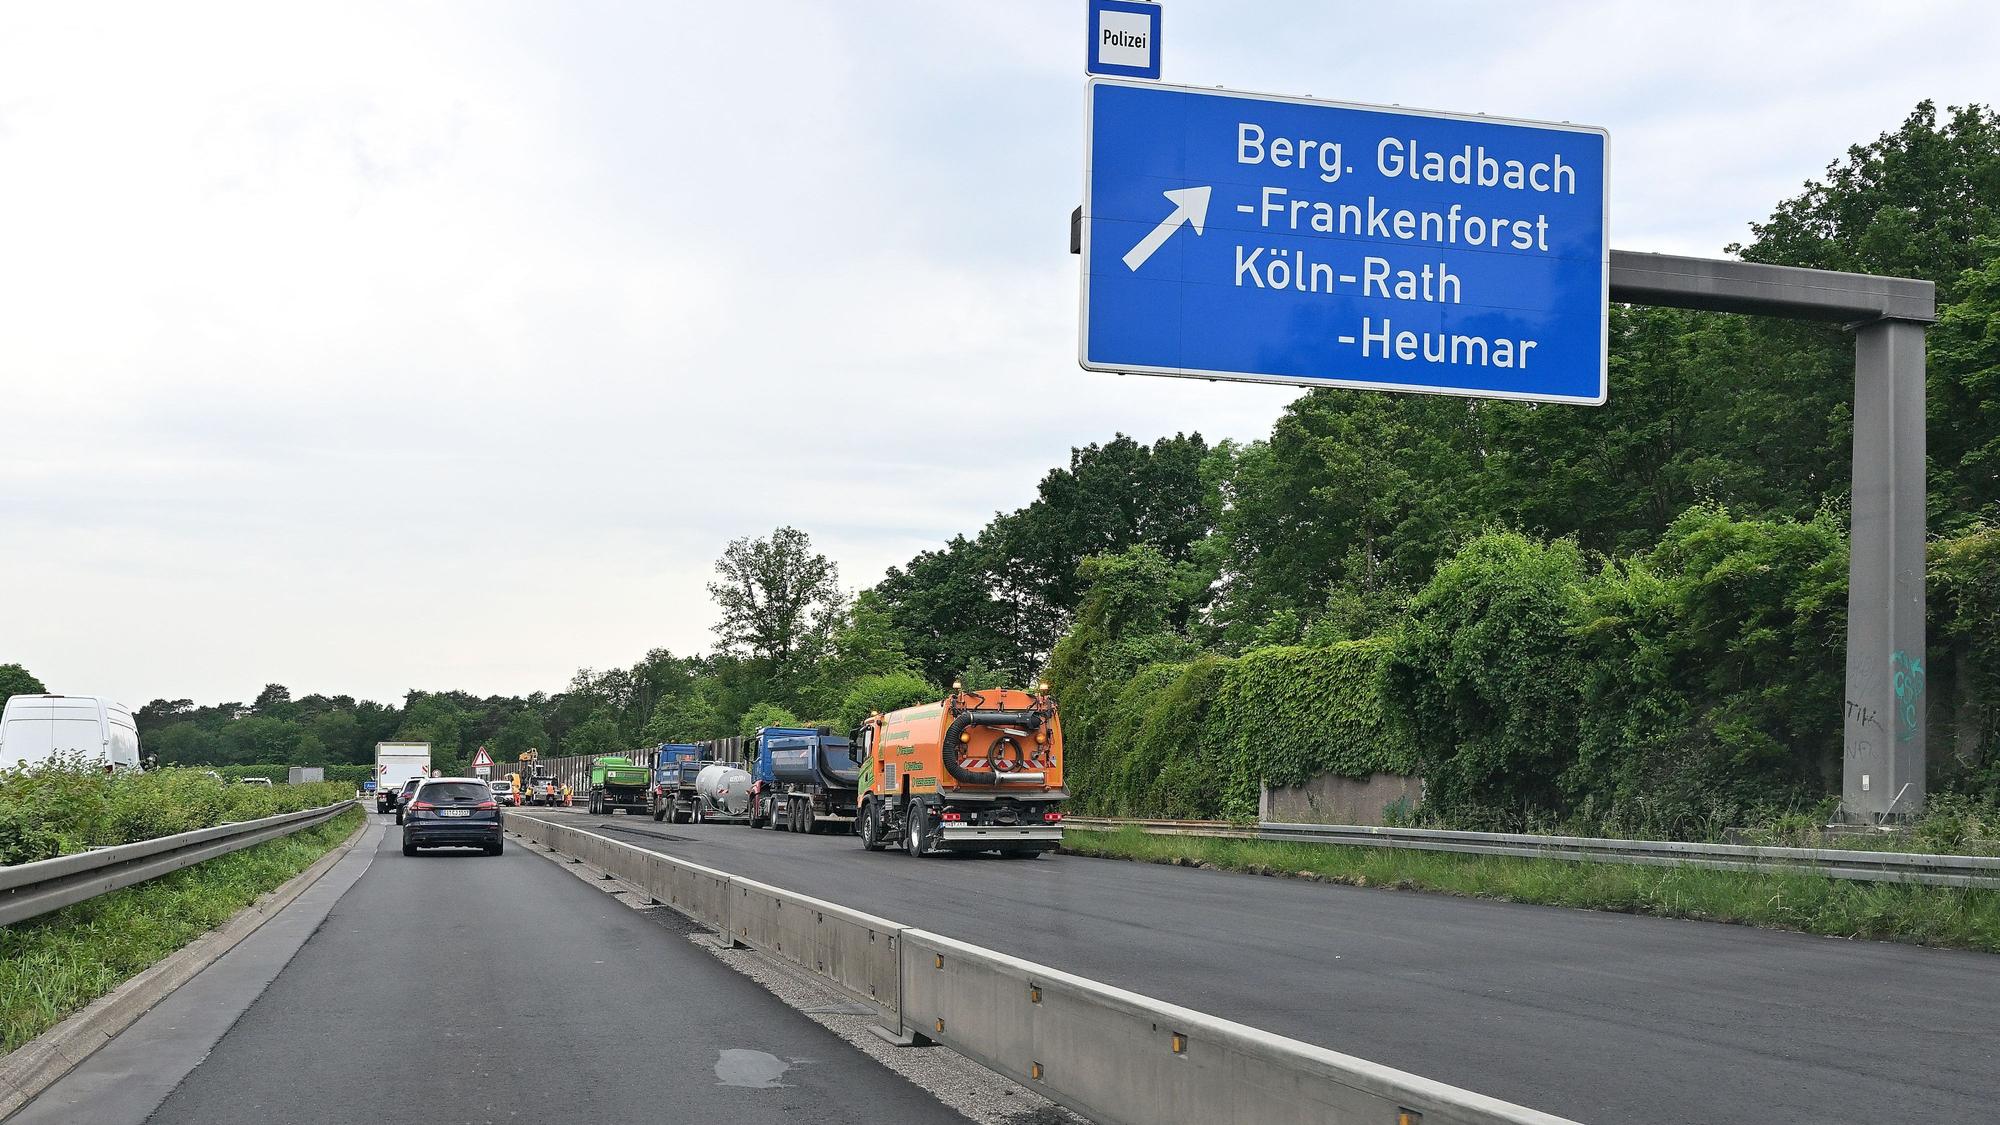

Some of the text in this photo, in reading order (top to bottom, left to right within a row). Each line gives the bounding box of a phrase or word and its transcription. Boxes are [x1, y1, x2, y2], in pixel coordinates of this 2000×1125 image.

[1103, 29, 1146, 49] Polizei
[1238, 122, 1576, 195] Berg. Gladbach
[1236, 186, 1549, 252] -Frankenforst
[1235, 245, 1461, 304] Köln-Rath
[1338, 317, 1538, 369] -Heumar
